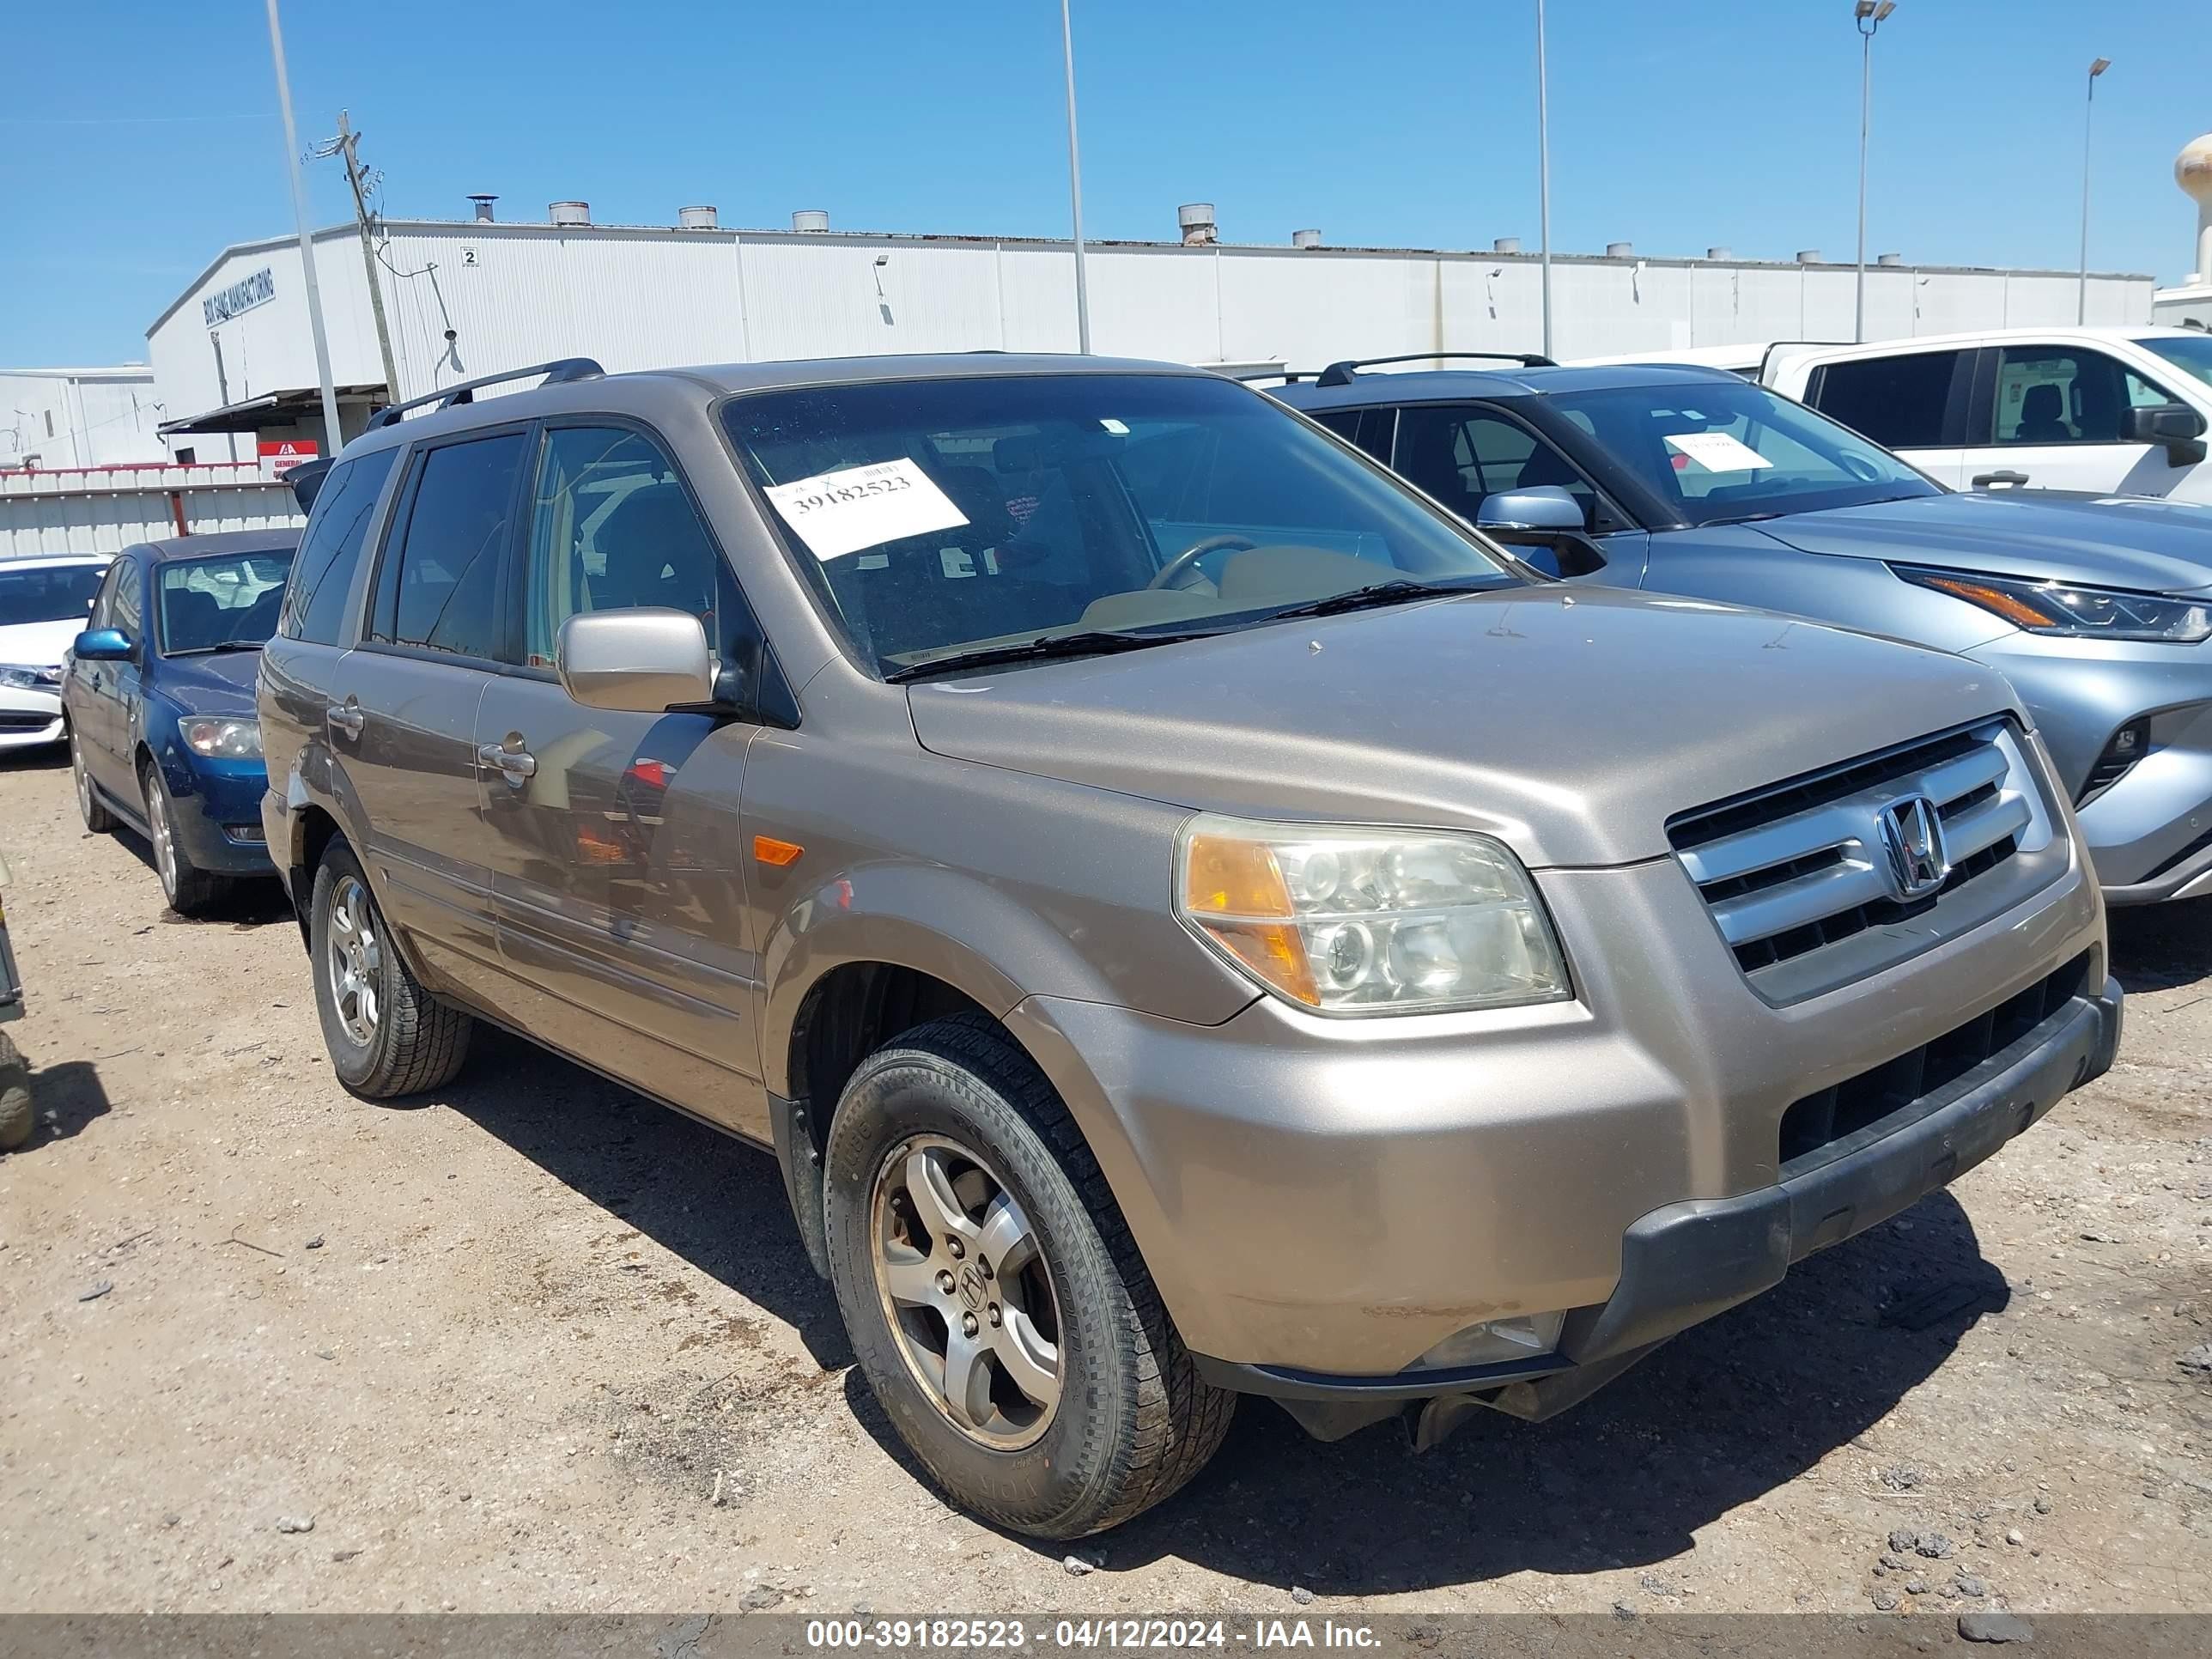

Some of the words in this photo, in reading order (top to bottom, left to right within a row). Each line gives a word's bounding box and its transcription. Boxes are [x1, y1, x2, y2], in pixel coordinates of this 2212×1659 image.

[465, 252, 475, 263] 2
[203, 297, 216, 325] BOX
[228, 267, 274, 313] MANUFACTURING
[793, 476, 911, 514] 39182523
